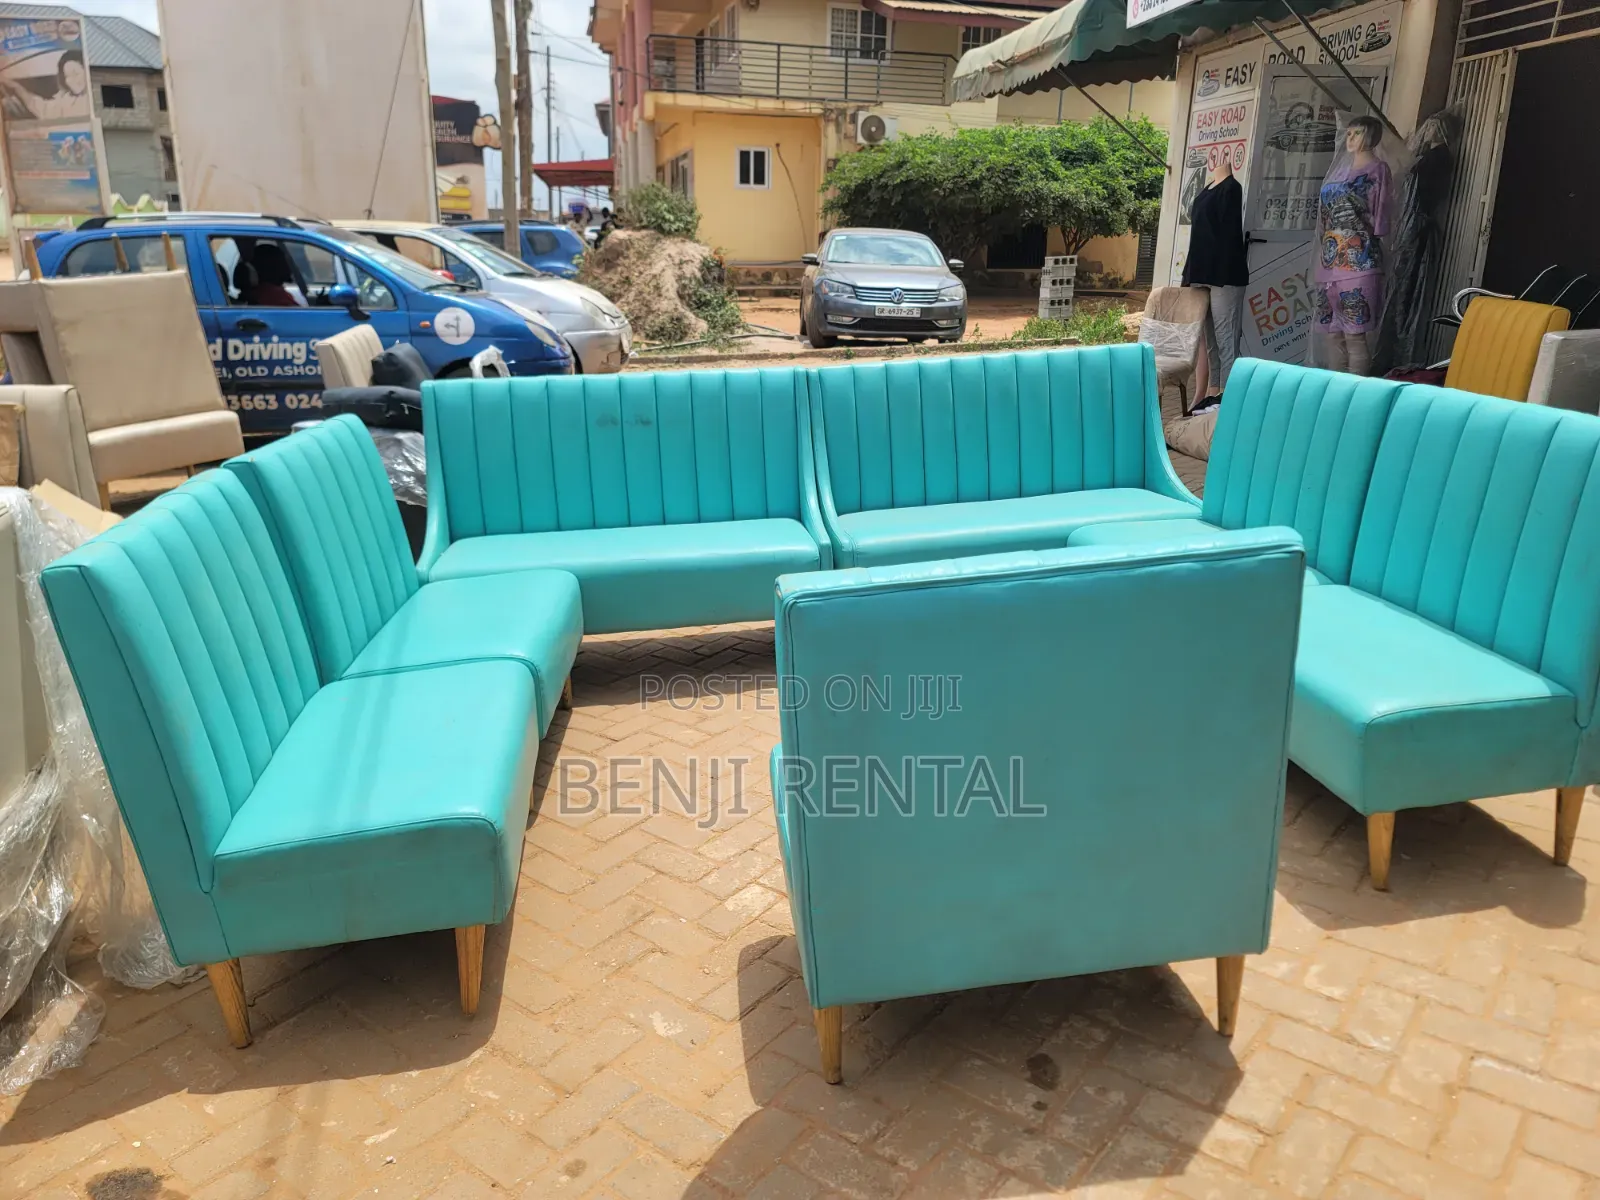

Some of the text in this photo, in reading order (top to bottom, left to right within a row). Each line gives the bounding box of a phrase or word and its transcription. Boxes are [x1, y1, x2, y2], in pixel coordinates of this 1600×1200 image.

[1224, 61, 1256, 88] EASY
[1196, 105, 1246, 130] EASY ROAD
[1198, 124, 1239, 142] Driving School
[1248, 268, 1309, 316] EASY
[1261, 325, 1293, 346] Driving
[227, 335, 307, 365] Driving
[235, 366, 269, 377] OLD
[273, 365, 322, 377] ASHO
